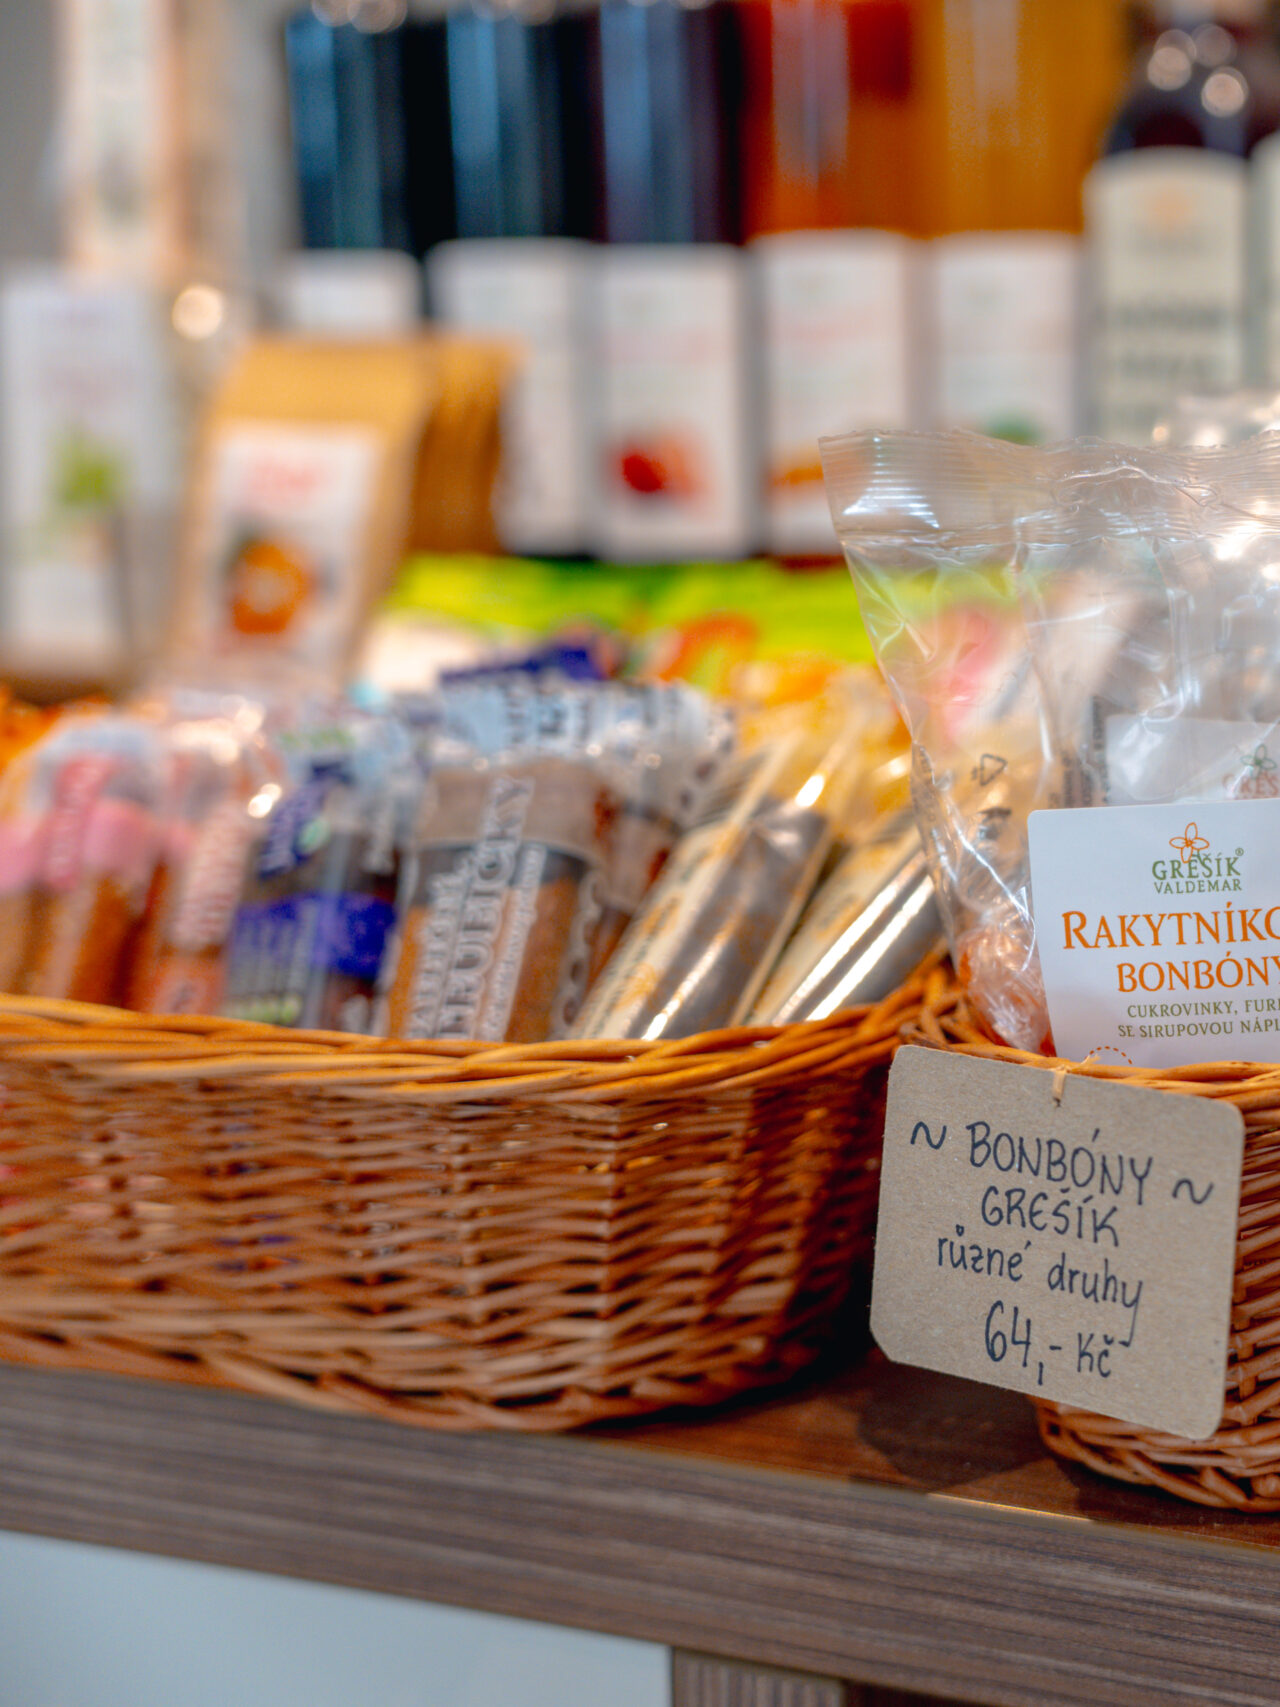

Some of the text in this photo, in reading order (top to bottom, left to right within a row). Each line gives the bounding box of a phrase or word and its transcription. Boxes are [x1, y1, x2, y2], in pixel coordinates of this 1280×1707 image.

[1152, 852, 1241, 881] GREŠÍK
[1154, 879, 1242, 895] VALDEMAR
[1127, 1000, 1238, 1019] CUKROVINKY,
[1118, 1023, 1136, 1038] SE
[1140, 1020, 1234, 1038] SIRUPOVOU
[937, 1224, 1144, 1348] různé druhy
[1076, 1332, 1114, 1379] Kč
